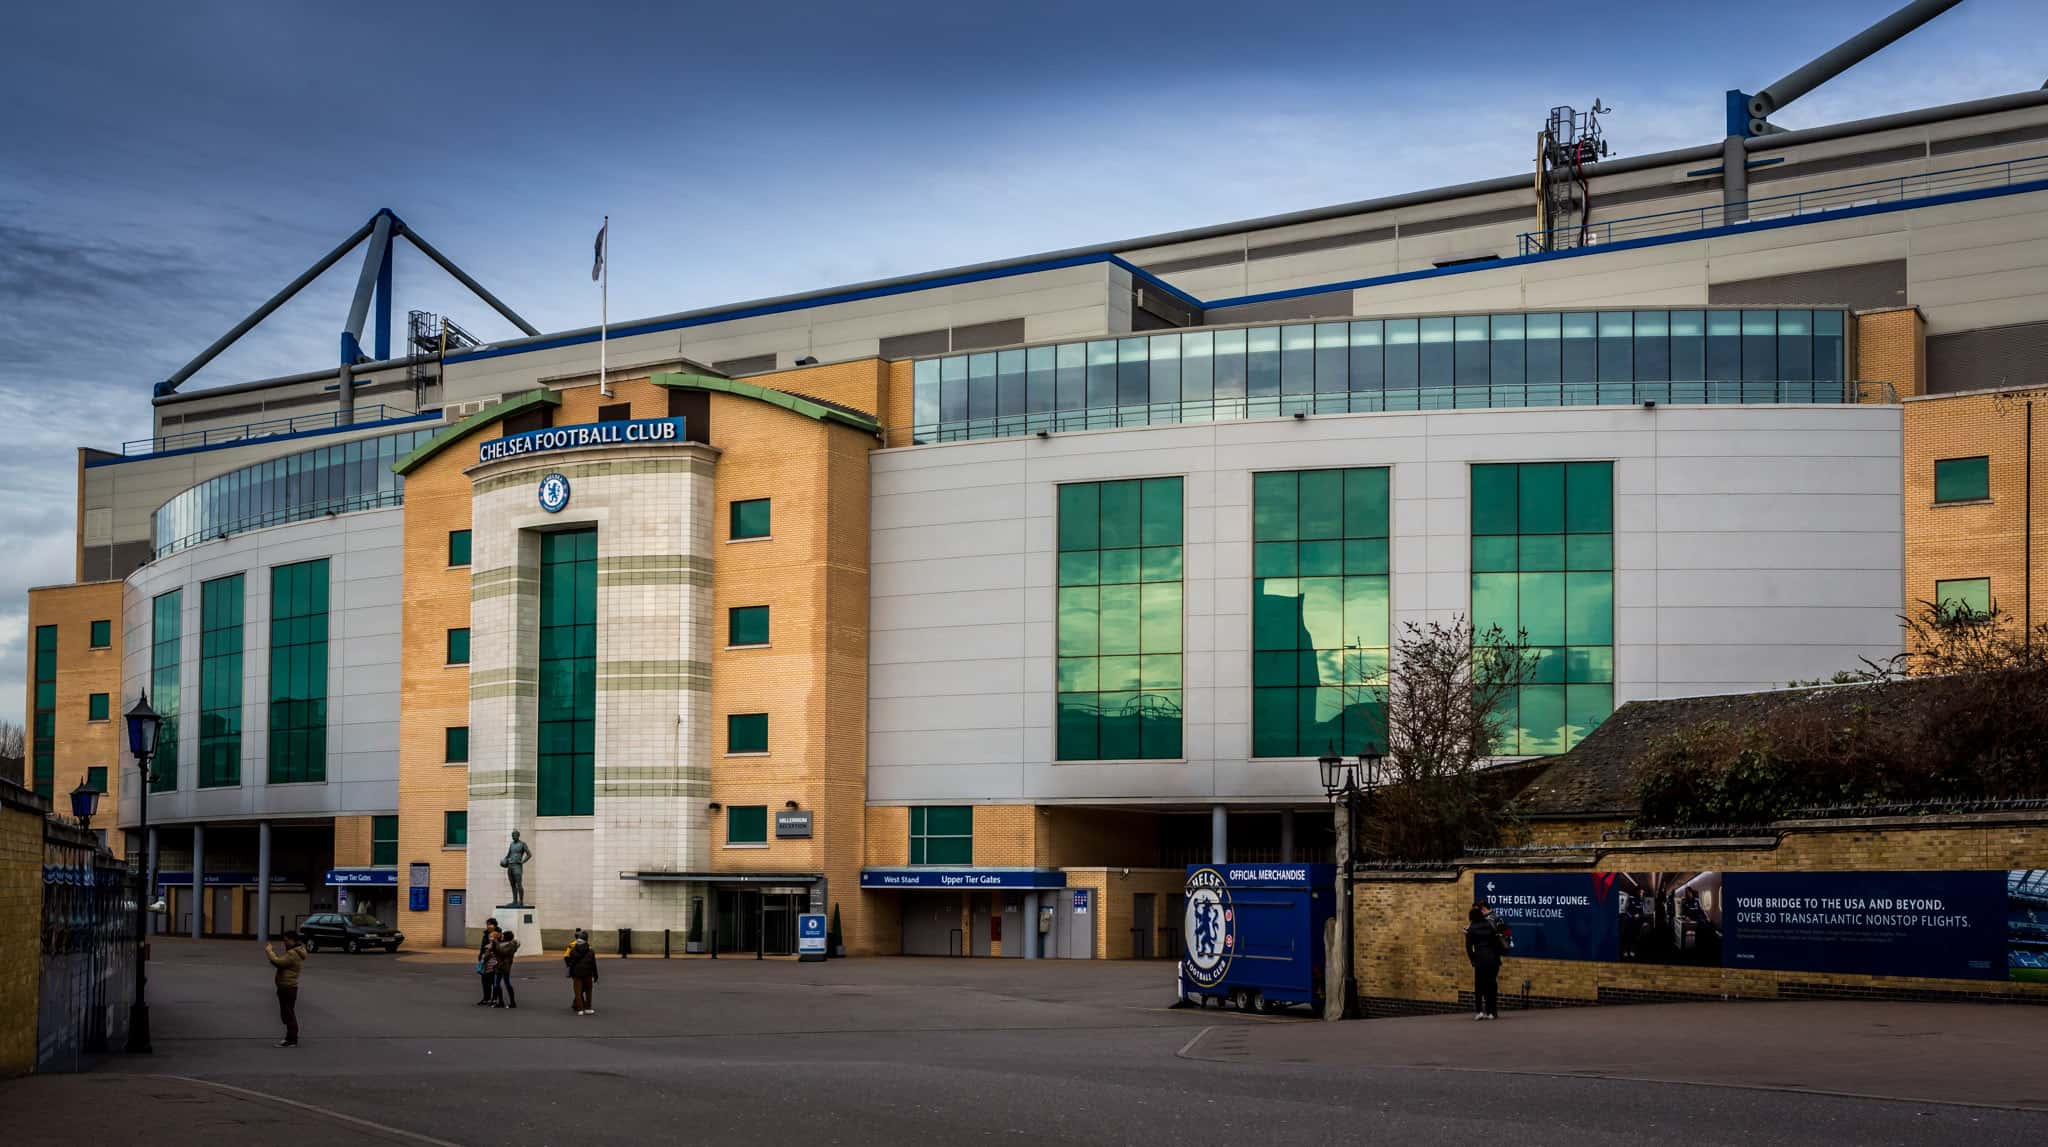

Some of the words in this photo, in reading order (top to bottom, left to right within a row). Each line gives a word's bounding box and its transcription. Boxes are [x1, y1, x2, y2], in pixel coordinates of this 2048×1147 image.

[480, 436, 532, 461] CHELSEA
[535, 425, 622, 450] FOOTBALL
[626, 422, 675, 441] CLUB
[884, 876, 900, 884] West
[901, 876, 920, 884] Stand
[941, 875, 964, 885] Upper
[965, 875, 978, 884] Tier
[980, 875, 1001, 884] Gates
[1229, 869, 1257, 880] OFFICIAL
[1258, 869, 1306, 881] MERCHANDISE
[1185, 873, 1223, 899] CHELSEA
[1487, 896, 1497, 905] TO
[1499, 895, 1512, 905] THE
[1514, 895, 1537, 905] DELTA
[1556, 896, 1590, 906] LOUNGE.
[1736, 897, 1763, 909] YOUR
[1766, 898, 1801, 909] BRIDGE
[1804, 898, 1818, 909] TO
[1821, 899, 1842, 909] THE
[1844, 899, 1866, 910] USA
[1869, 899, 1893, 910] AND
[1896, 900, 1945, 911] BEYOND.
[1492, 908, 1523, 918] ERYONE
[1525, 908, 1565, 919] WELCOME.
[1736, 912, 1762, 923] OVER
[1764, 913, 1777, 923] 30
[1780, 913, 1863, 925] TRANSATLANTIC
[1866, 915, 1918, 926] NONSTOP
[1921, 915, 1971, 928] FLIGHTS.
[1186, 959, 1213, 982] FOOTBALL
[1213, 960, 1226, 979] CLUB
